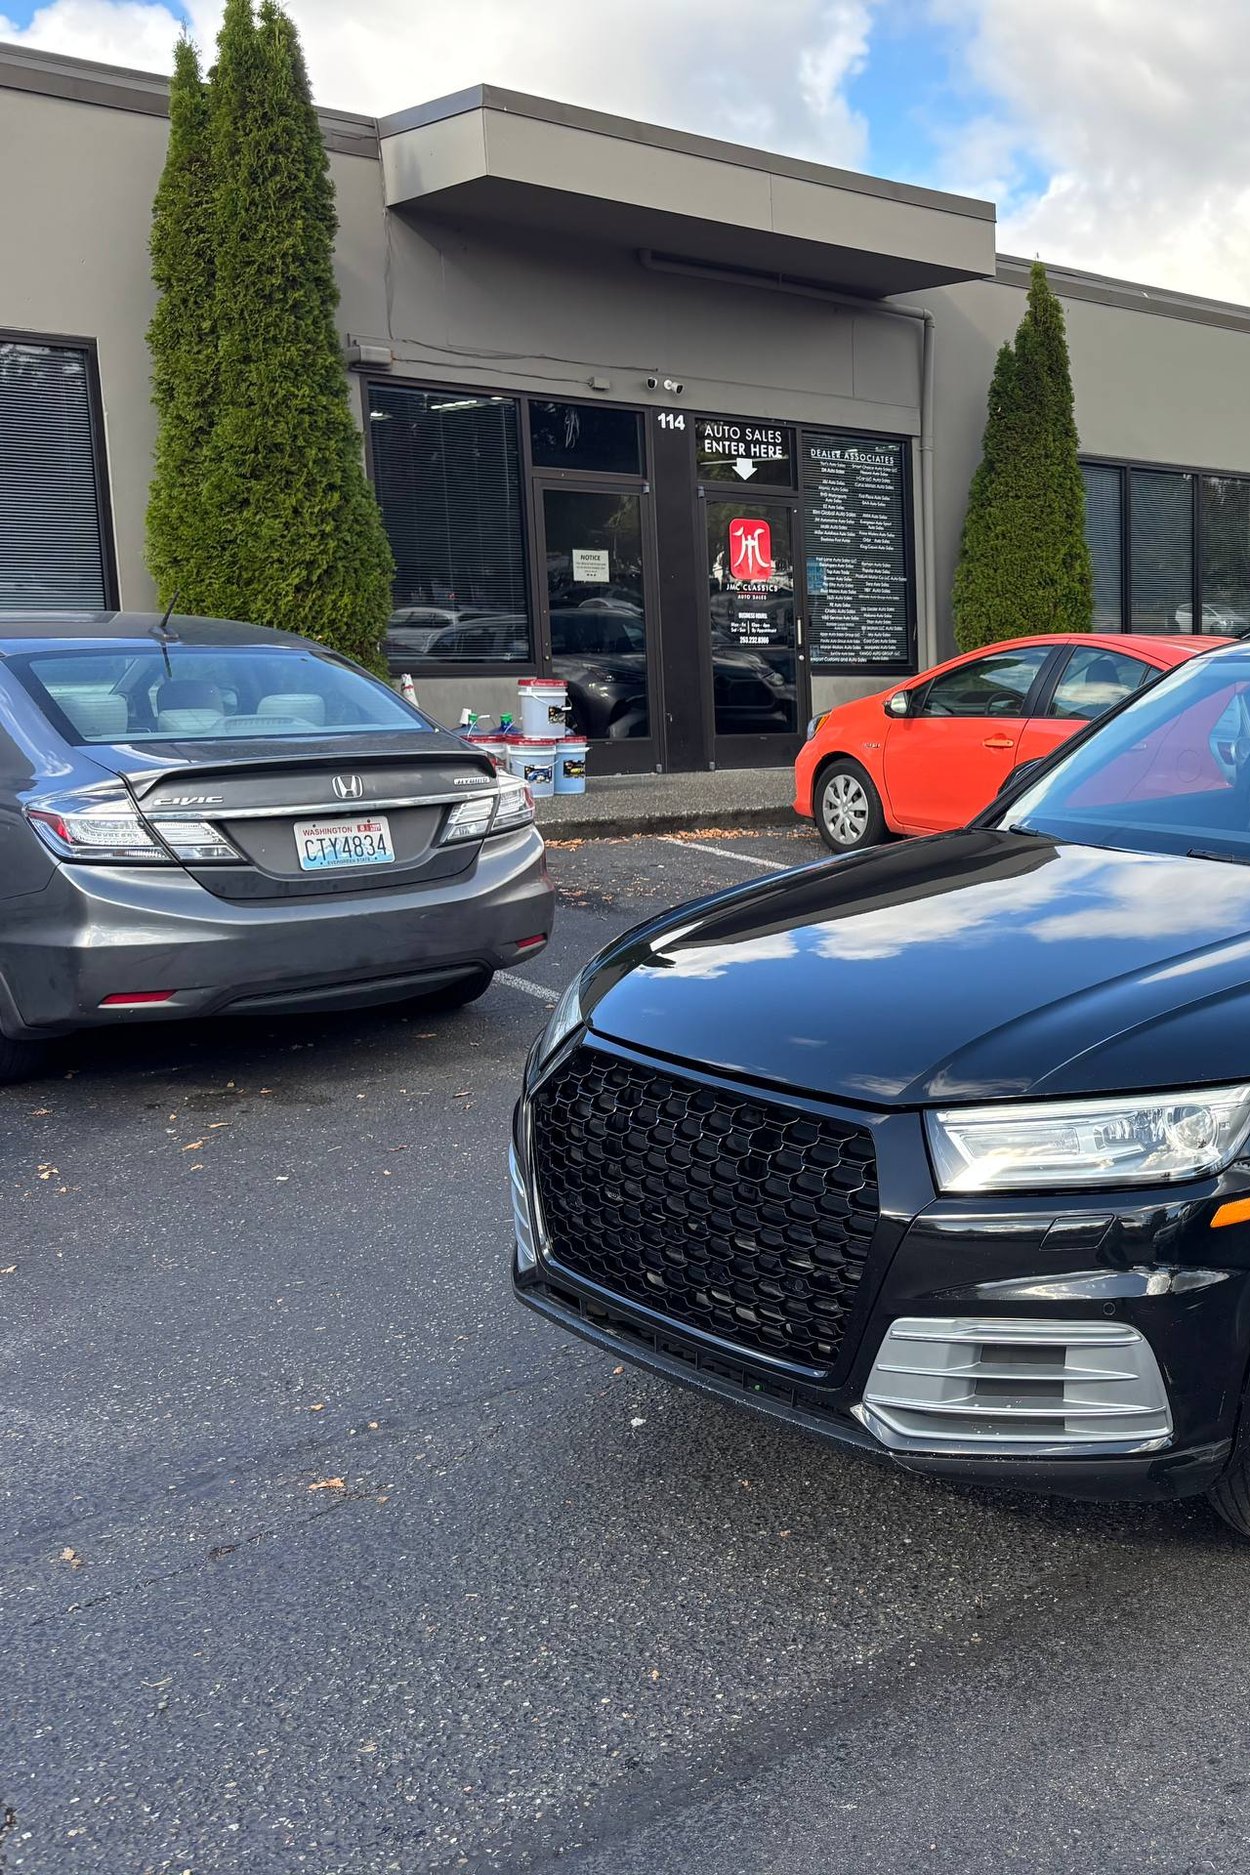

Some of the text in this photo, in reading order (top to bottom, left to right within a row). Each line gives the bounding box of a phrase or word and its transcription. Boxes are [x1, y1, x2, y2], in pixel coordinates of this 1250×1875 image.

[658, 413, 685, 430] 114
[705, 425, 782, 443] AUTO SALES
[705, 440, 782, 459] ENTER HERE
[811, 448, 894, 464] DEALER ASSOCIATES
[726, 582, 778, 592] JMC CLASSICS
[153, 796, 223, 806] CIVIC
[303, 827, 353, 836] WASHINGTON
[305, 833, 387, 862] CTY4834
